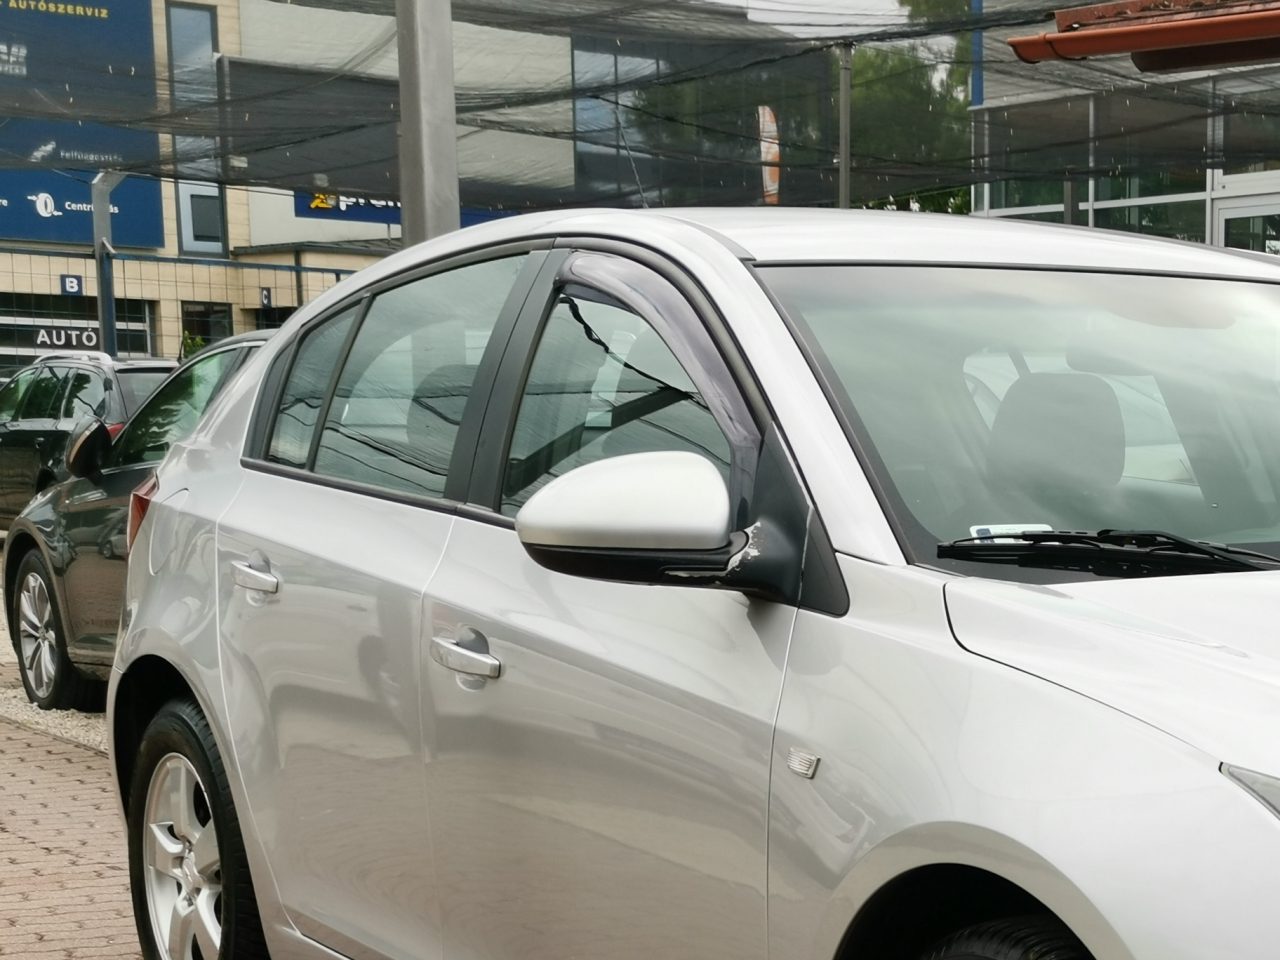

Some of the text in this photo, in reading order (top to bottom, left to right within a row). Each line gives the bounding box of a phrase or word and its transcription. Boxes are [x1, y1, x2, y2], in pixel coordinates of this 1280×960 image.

[65, 278, 78, 292] B
[262, 290, 269, 303] C
[36, 328, 97, 346] AUTÓ
